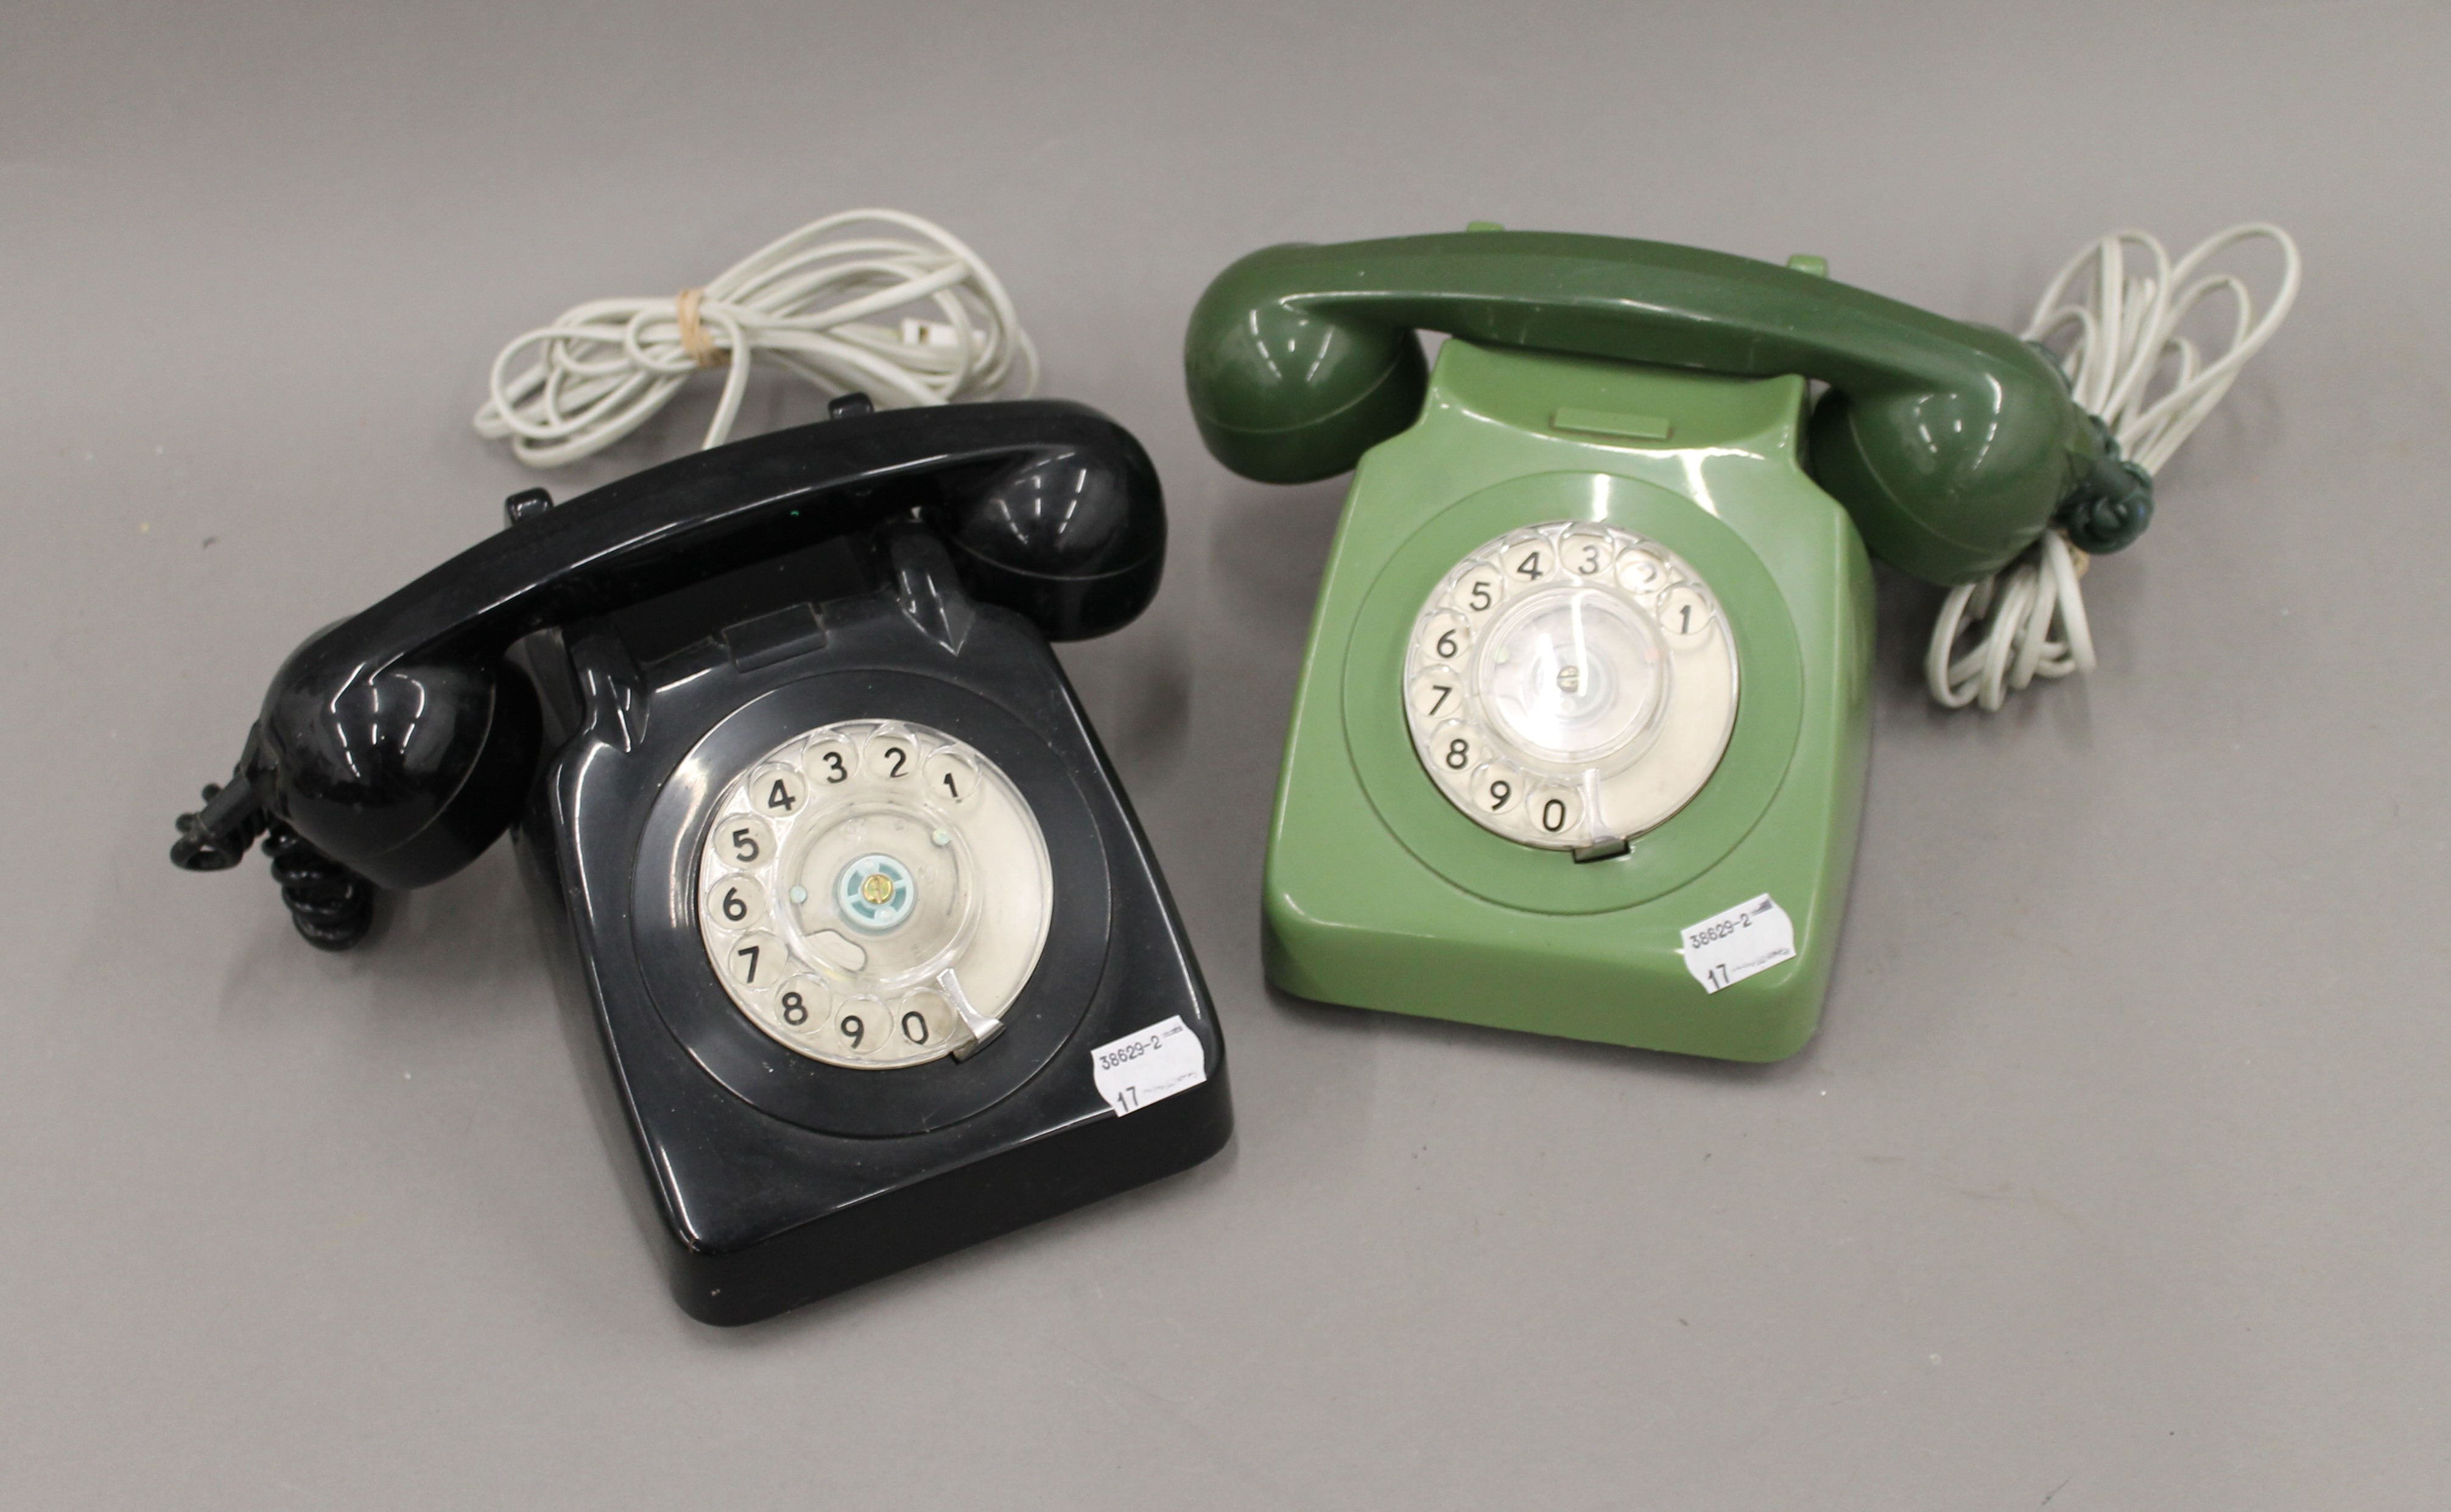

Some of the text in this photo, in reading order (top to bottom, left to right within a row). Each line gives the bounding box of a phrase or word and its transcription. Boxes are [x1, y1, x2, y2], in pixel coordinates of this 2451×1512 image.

[1517, 552, 1542, 580] 4
[1578, 546, 1599, 575] 3
[1469, 581, 1491, 610] 5
[1679, 605, 1690, 633] 1
[1437, 630, 1457, 658] 6
[1429, 686, 1451, 715] 7
[823, 752, 848, 783] 3
[885, 748, 909, 778] 2
[1446, 739, 1469, 769] 8
[768, 779, 795, 811] 4
[944, 773, 959, 798] 1
[1489, 781, 1510, 811] 9
[1542, 799, 1565, 831] 0
[733, 829, 759, 862] 5
[723, 887, 747, 920] 6
[1690, 913, 1752, 949] 38629-2
[739, 946, 759, 983] 7
[1708, 963, 1729, 989] 17
[781, 991, 808, 1025] 8
[840, 1015, 863, 1048] 9
[902, 1011, 929, 1044] 0
[1100, 1035, 1162, 1070] 38629-2
[1117, 1086, 1138, 1112] 17
